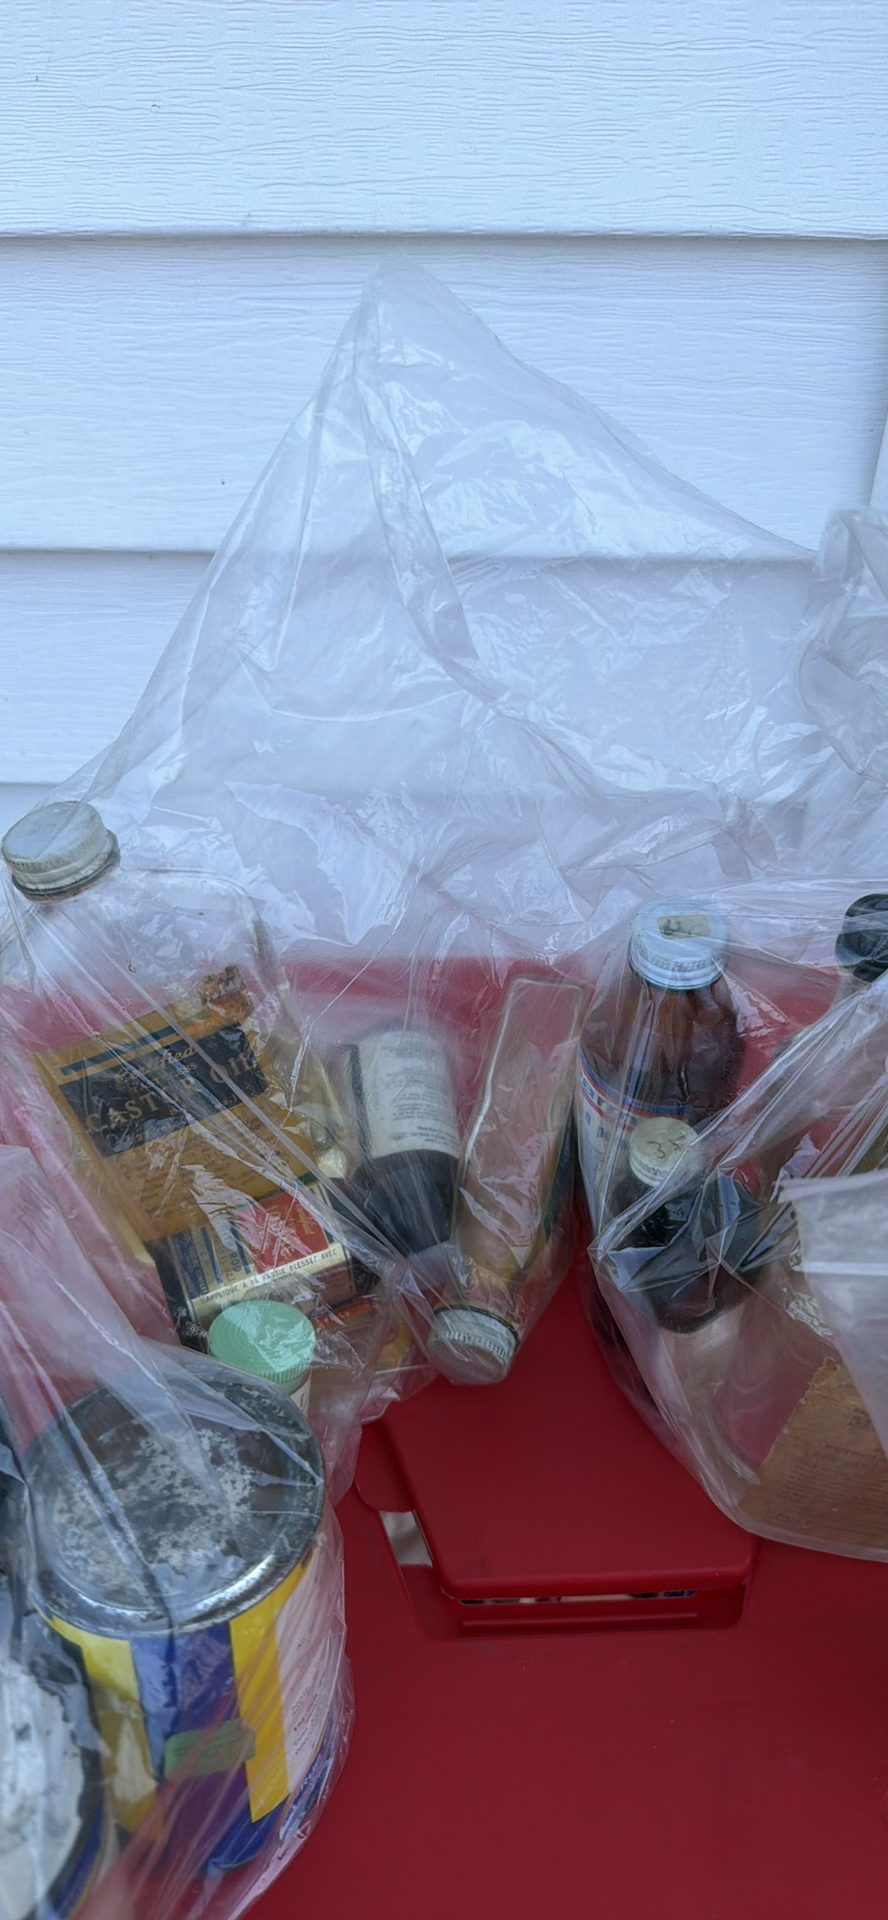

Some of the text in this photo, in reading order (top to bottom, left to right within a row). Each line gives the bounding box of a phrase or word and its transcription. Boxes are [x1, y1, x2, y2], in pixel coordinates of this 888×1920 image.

[210, 1052, 257, 1084] OIL
[228, 1251, 242, 1272] ROD
[320, 1248, 338, 1261] AVEC
